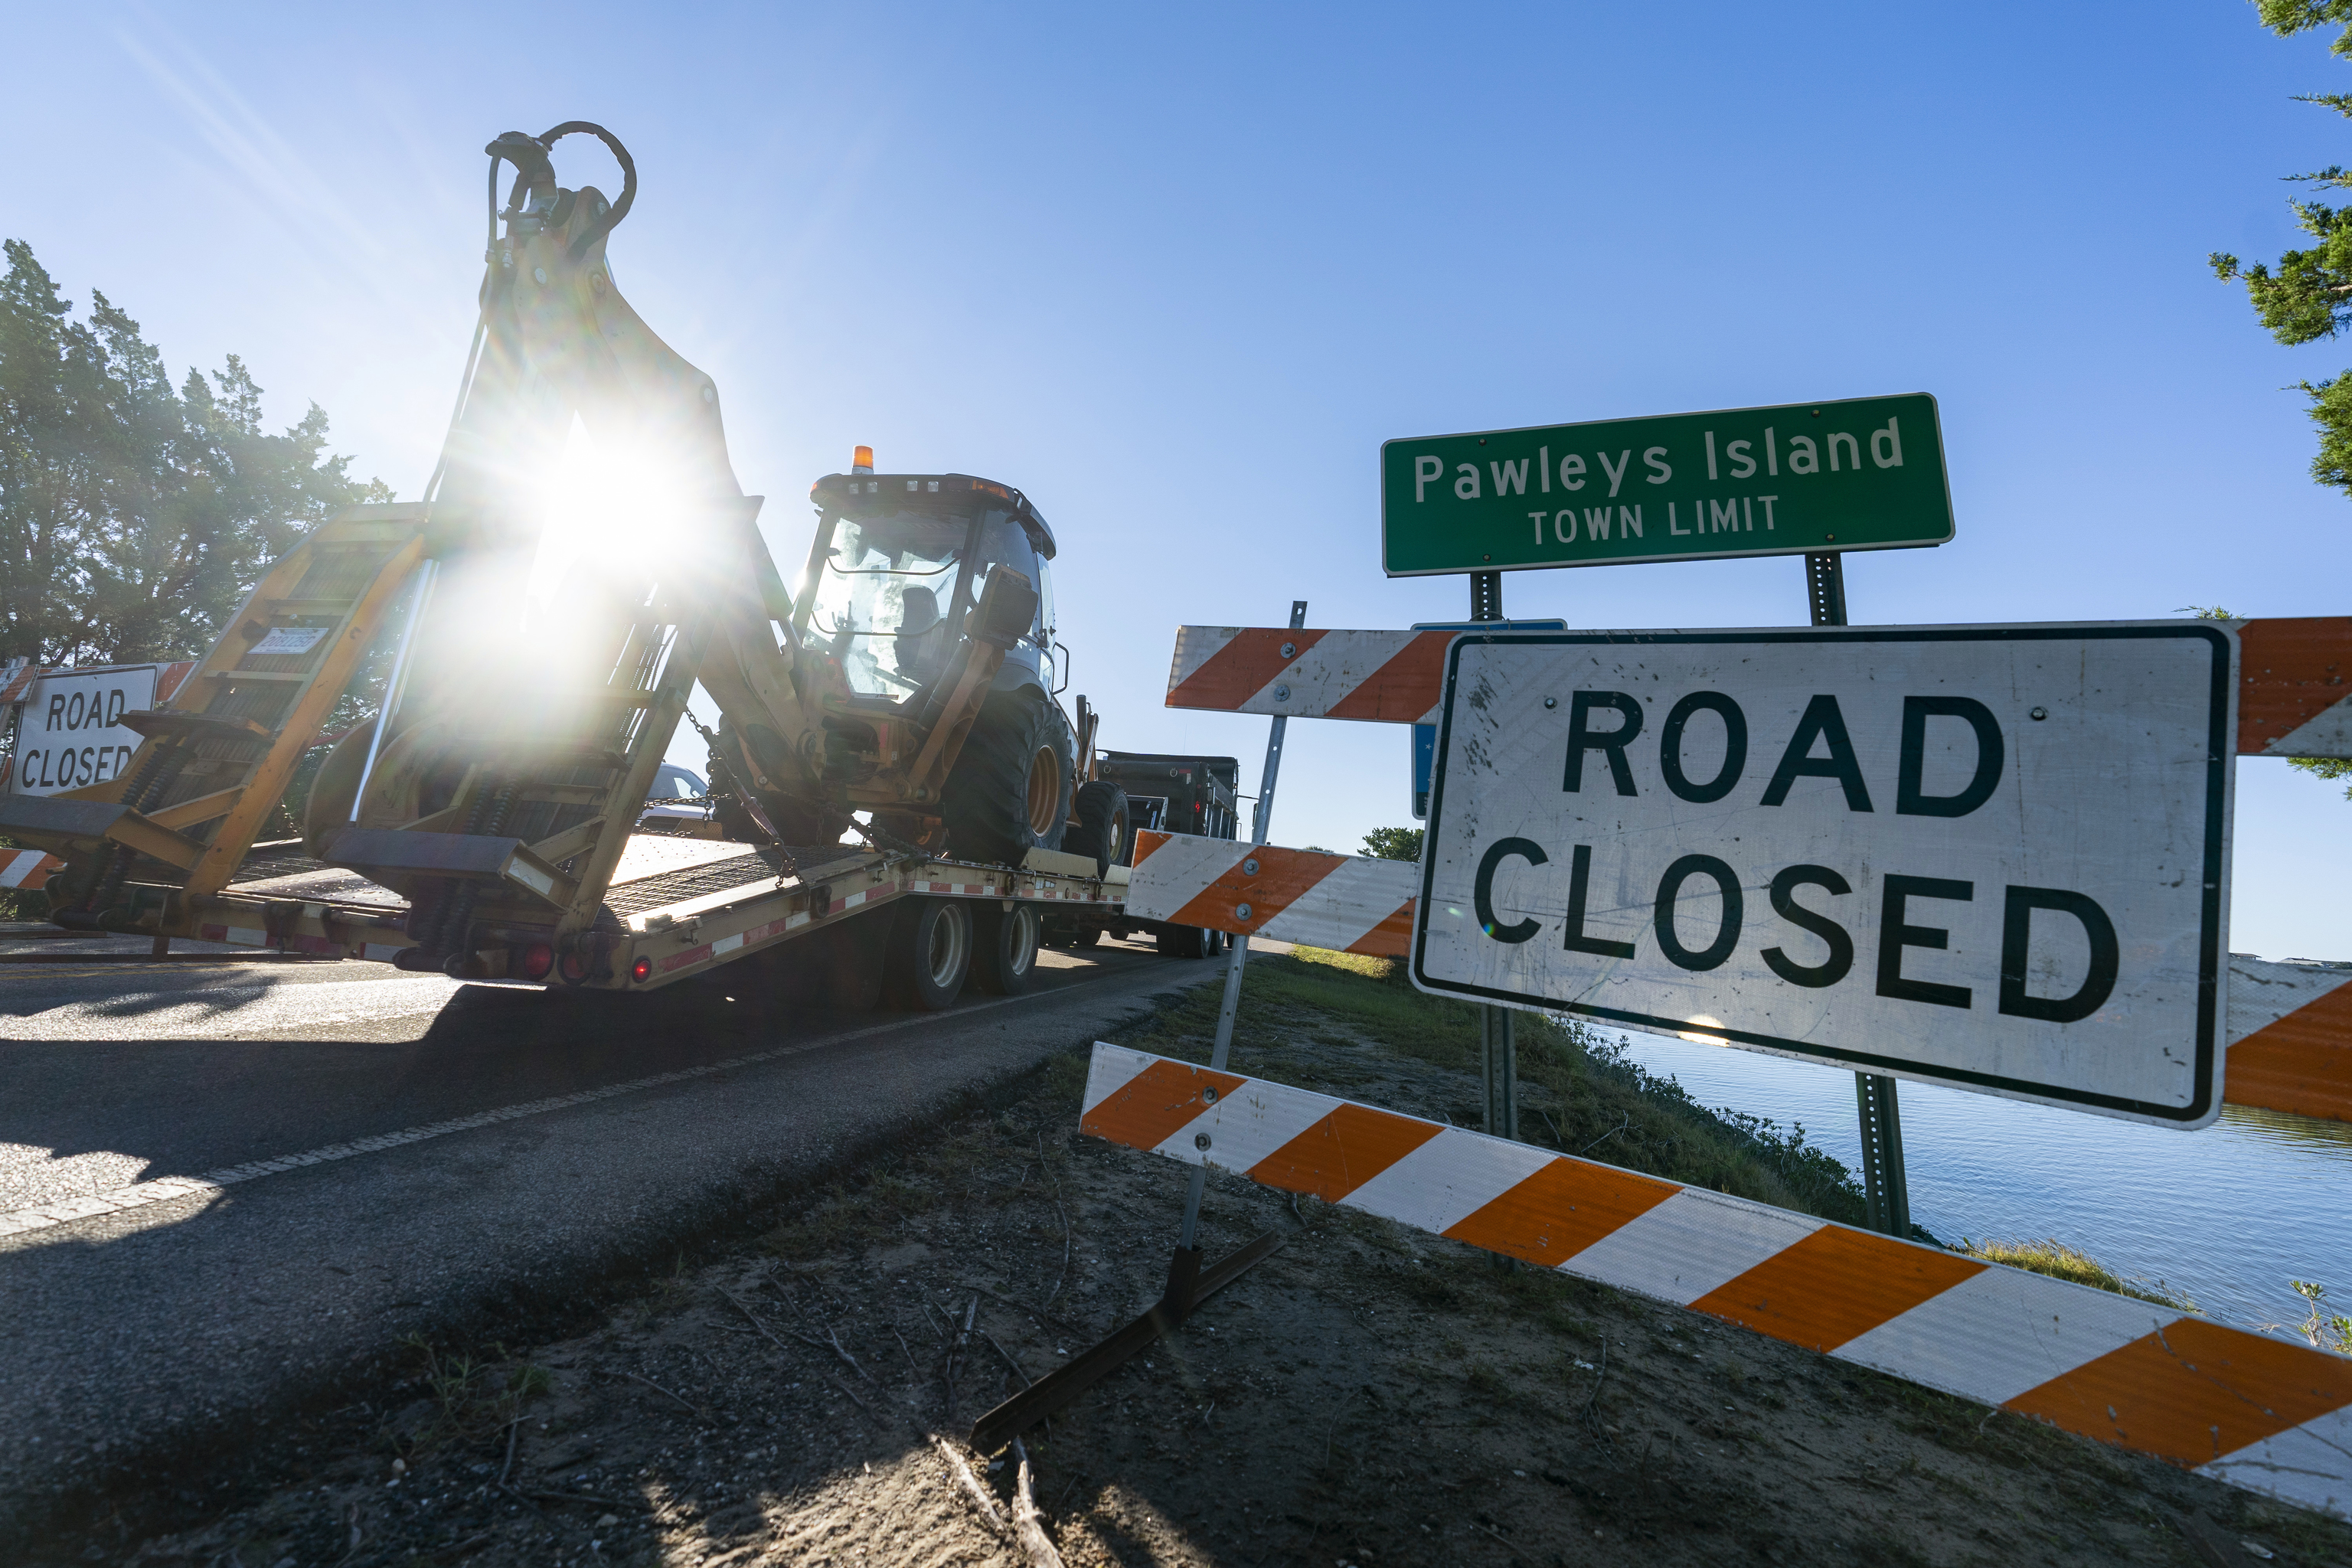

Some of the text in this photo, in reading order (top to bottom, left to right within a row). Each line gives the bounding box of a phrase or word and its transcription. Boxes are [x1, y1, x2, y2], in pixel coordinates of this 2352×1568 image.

[1415, 416, 1905, 502] Pawleys Island
[1528, 495, 1779, 545] TOWN LIMIT
[46, 689, 126, 732] ROAD
[1562, 690, 2005, 818] ROAD
[1473, 836, 2120, 1024] CLOSED
